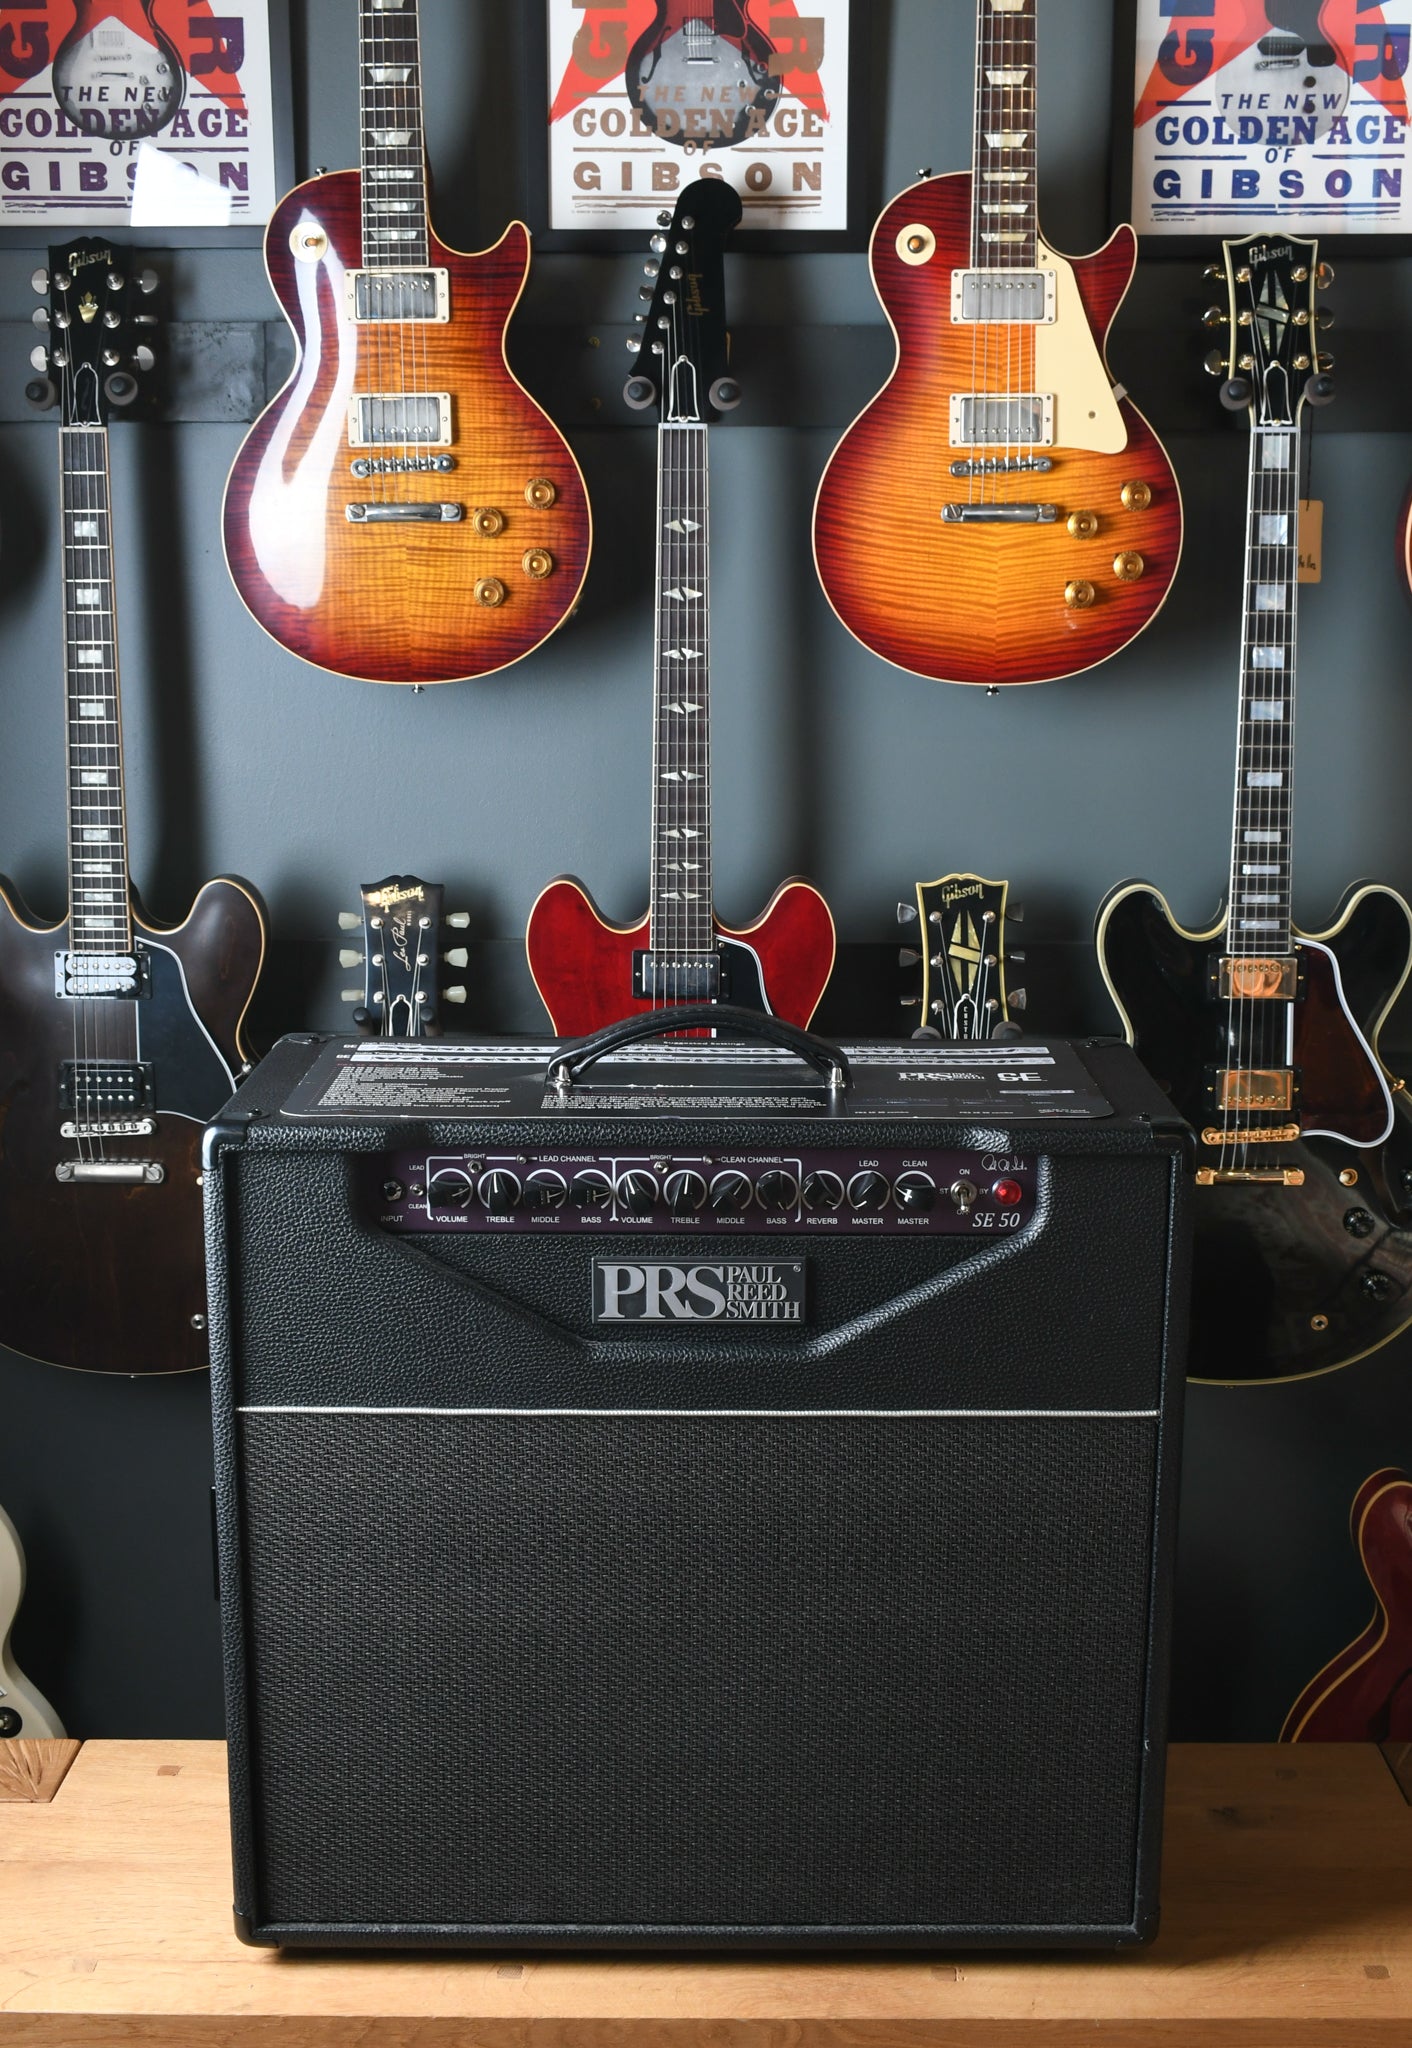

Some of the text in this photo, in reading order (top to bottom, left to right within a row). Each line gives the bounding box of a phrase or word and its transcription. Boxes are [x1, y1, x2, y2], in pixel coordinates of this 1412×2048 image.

[60, 86, 110, 102] THE
[636, 85, 759, 104] THE NEW
[1221, 93, 1342, 110] THE NEW
[0, 108, 248, 138] GOLDEN AGE
[572, 108, 824, 138] GOLDEN AGE
[1155, 114, 1406, 146] GOLDEN AGE
[109, 140, 140, 156] OF
[683, 140, 715, 156] OF
[1264, 147, 1296, 164] OF
[1, 161, 249, 191] GIBN
[1152, 168, 1403, 199] GIBSON
[68, 249, 113, 277] Gibson
[1248, 244, 1294, 269] Gibson
[378, 884, 425, 912] Gibson
[941, 883, 984, 909] Gibson
[997, 1072, 1042, 1082] SE
[560, 1155, 596, 1163] CHANNEL
[720, 1156, 784, 1164] CLEAN CHANNEL
[581, 1216, 602, 1224] BASS
[621, 1216, 654, 1224] VOLUME
[766, 1217, 787, 1225] BASS
[806, 1217, 838, 1225] REVERB
[851, 1217, 884, 1225] MASTER
[897, 1217, 930, 1225] MASTER
[972, 1212, 1021, 1228] SE 50
[726, 1265, 782, 1284] PAUL
[598, 1265, 727, 1319] PRS
[726, 1283, 788, 1301] REED
[726, 1301, 801, 1319] SMITH
